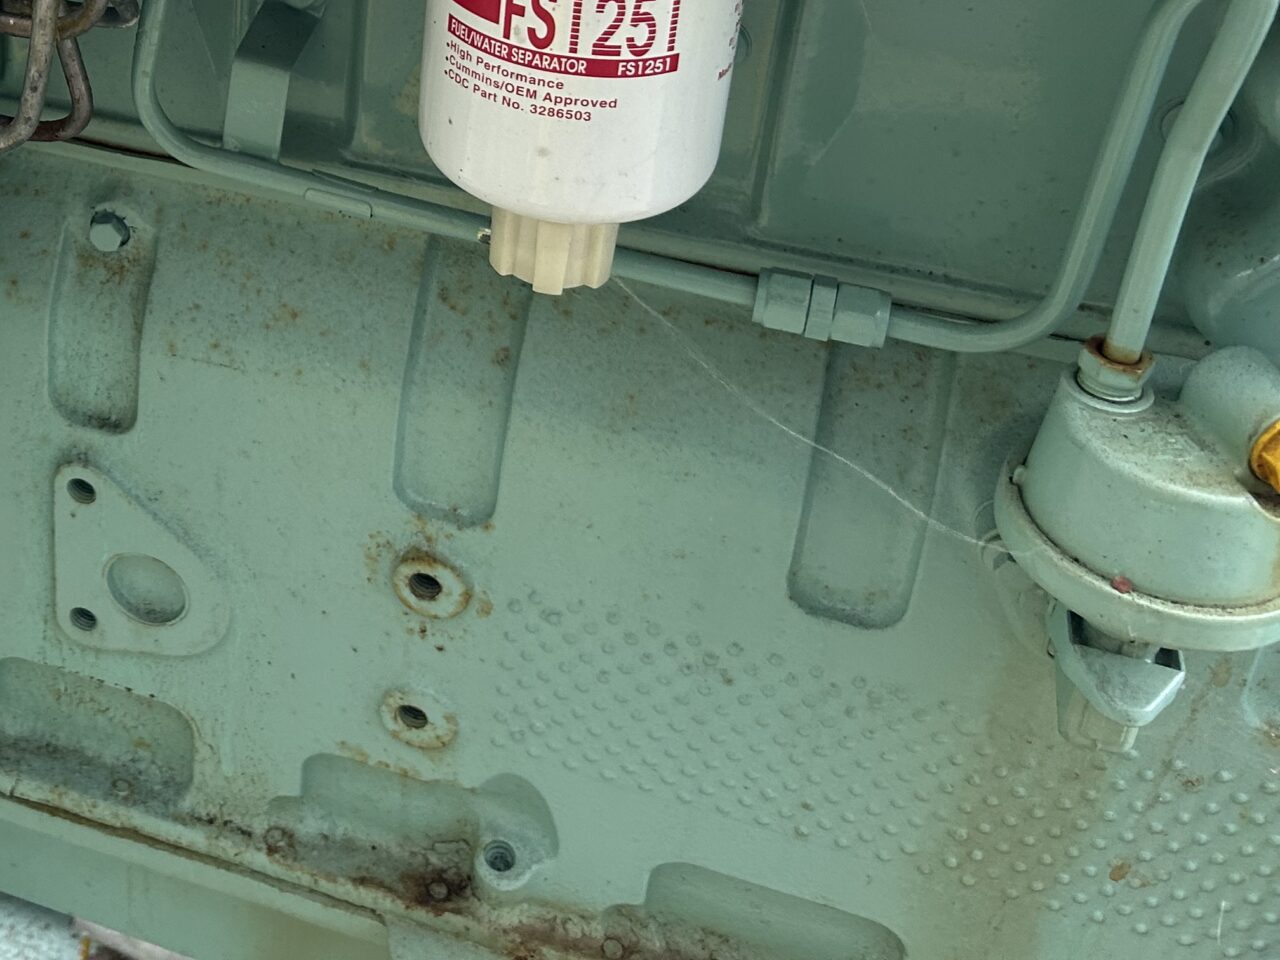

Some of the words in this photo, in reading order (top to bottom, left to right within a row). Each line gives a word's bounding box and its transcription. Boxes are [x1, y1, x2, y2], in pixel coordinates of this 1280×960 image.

[450, 17, 508, 58] FUEL/WATER
[511, 48, 587, 74] SEPARATOR
[617, 58, 671, 76] FS1251
[476, 54, 564, 90] Performance
[473, 83, 498, 103] Part
[502, 96, 524, 111] No.
[529, 104, 592, 122] 3286503
[543, 92, 618, 110] Approved
